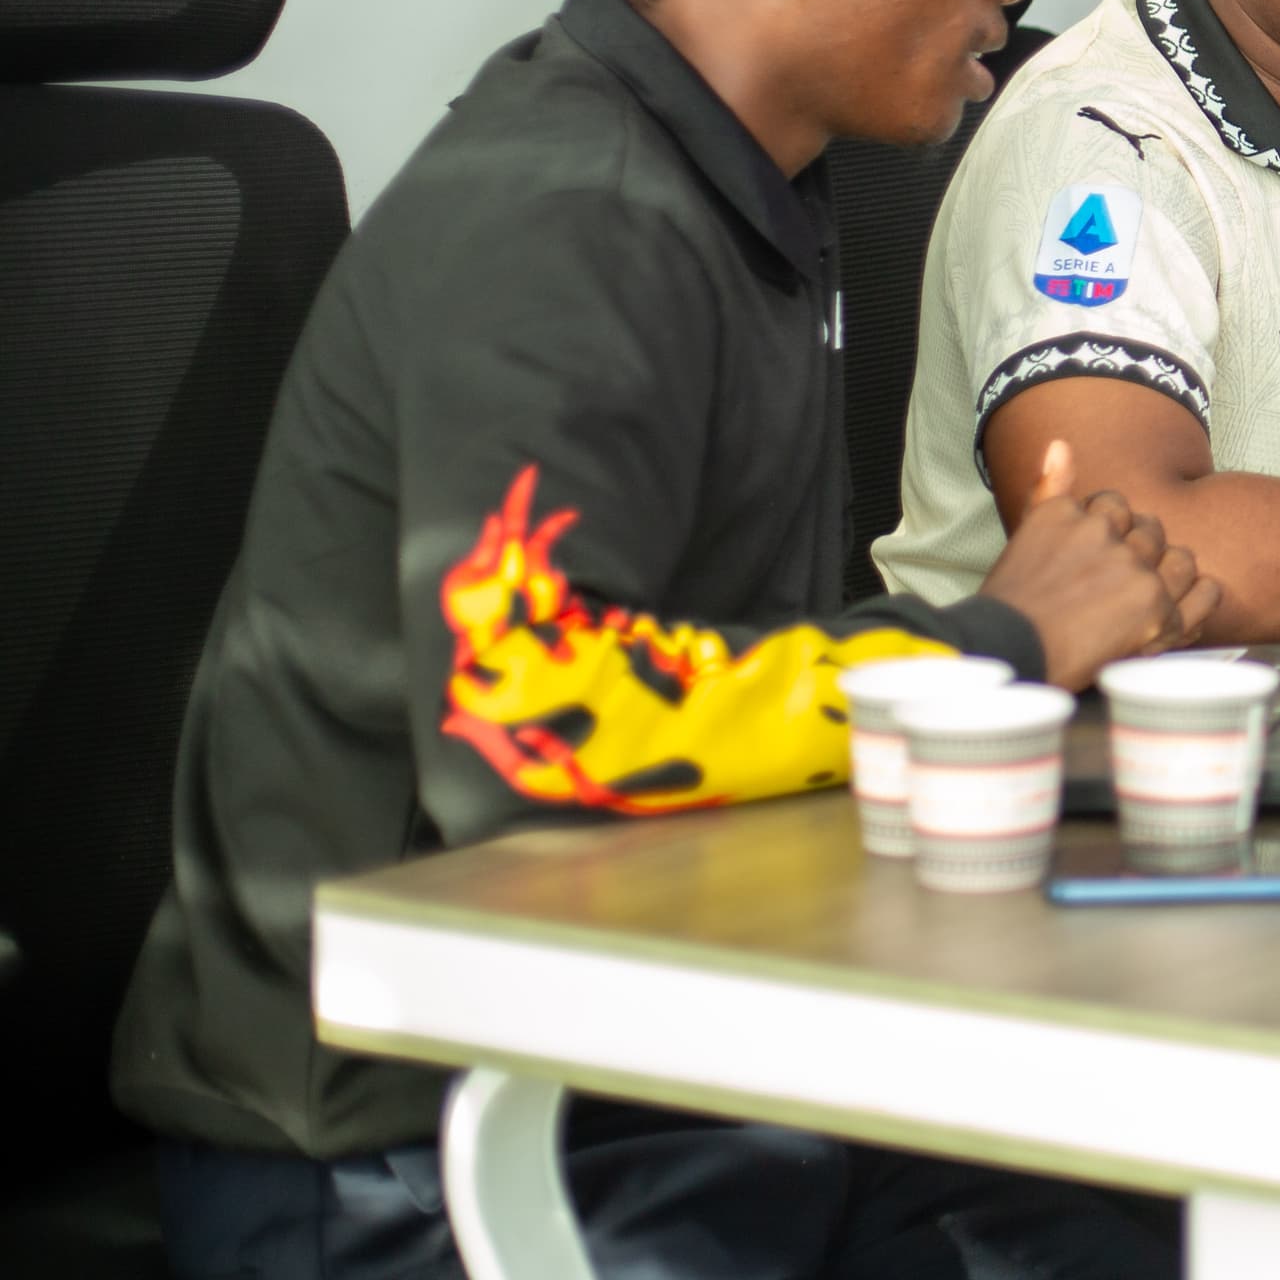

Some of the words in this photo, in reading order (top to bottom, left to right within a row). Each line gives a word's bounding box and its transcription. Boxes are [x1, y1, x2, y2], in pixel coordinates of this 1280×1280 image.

[1053, 259, 1099, 273] SERIE
[1104, 262, 1115, 273] A
[1072, 278, 1115, 299] TIM
